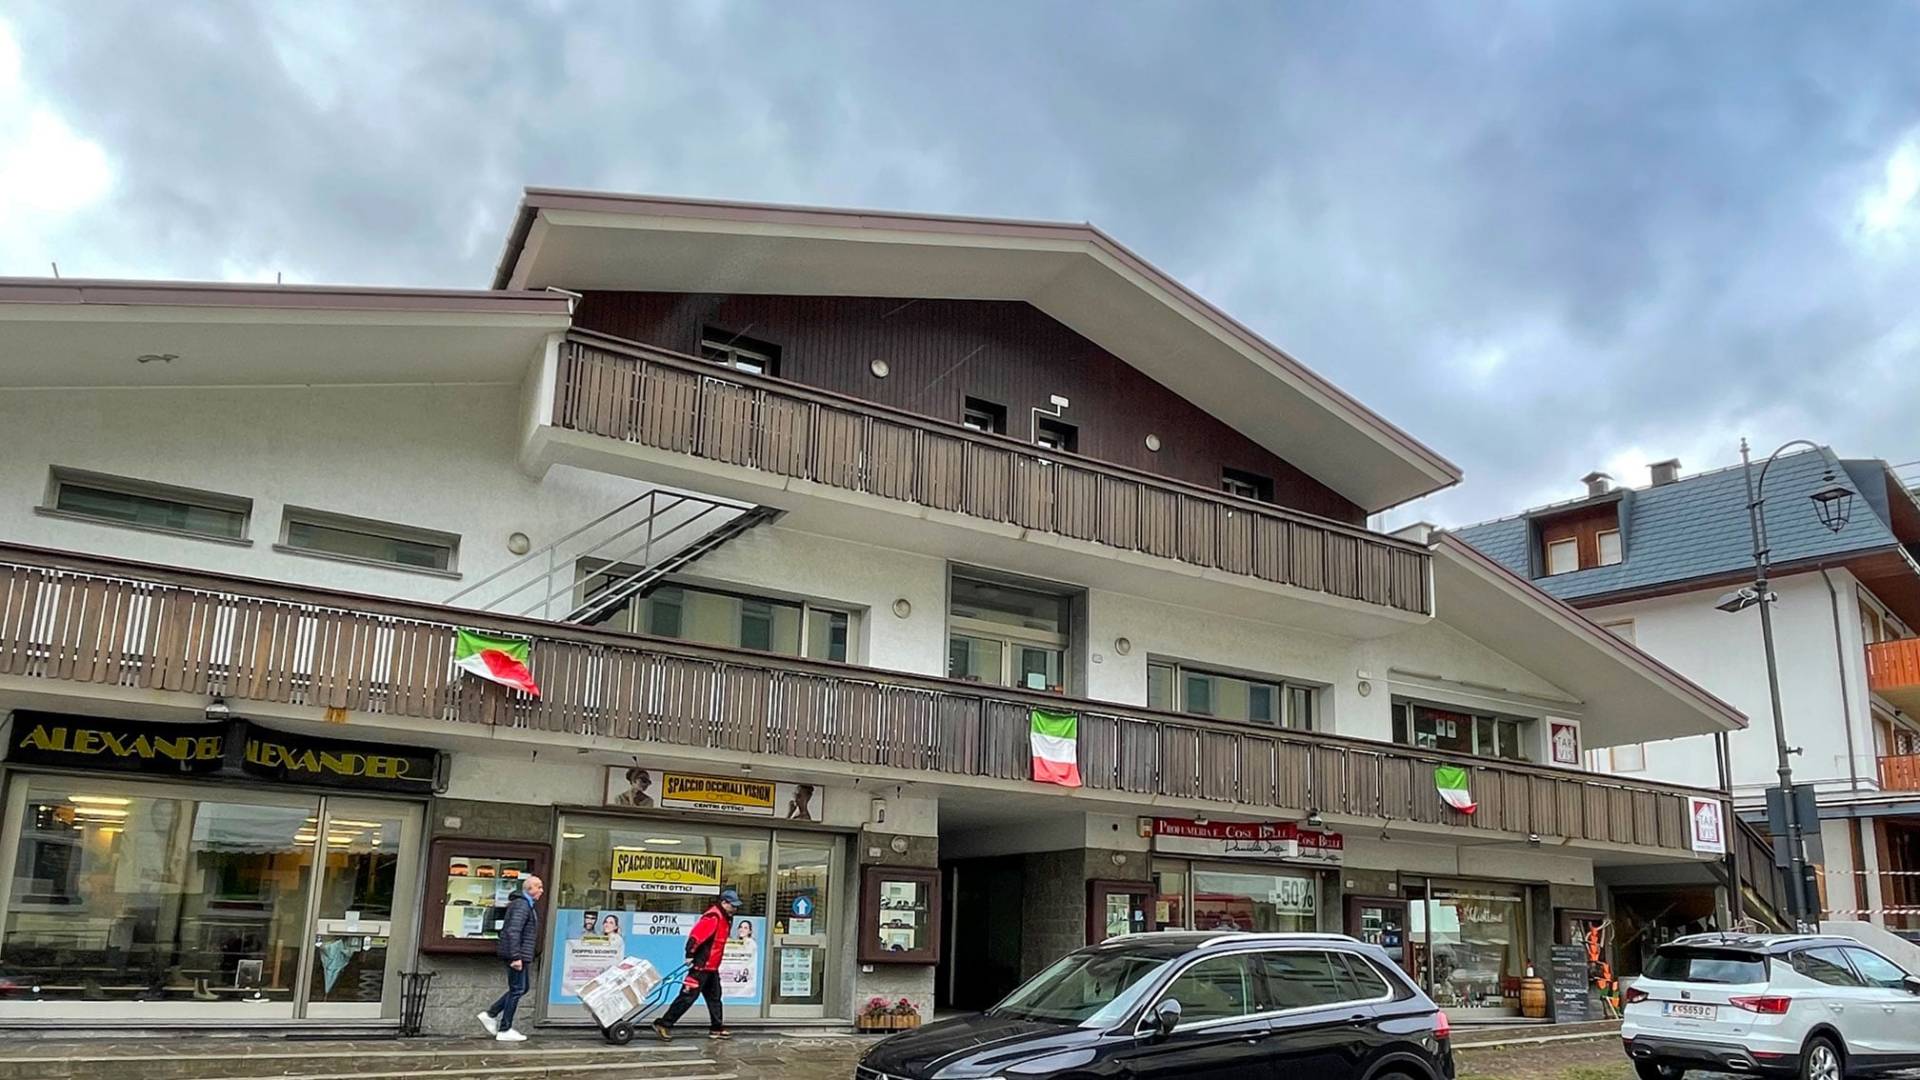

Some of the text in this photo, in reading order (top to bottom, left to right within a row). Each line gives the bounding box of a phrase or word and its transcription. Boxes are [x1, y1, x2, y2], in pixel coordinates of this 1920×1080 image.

[667, 777, 771, 802] SPACCIO OCCHIALI VISION
[617, 854, 717, 880] SPACCIO OCCHIALI VISION
[651, 914, 678, 924] OPTIK
[649, 925, 681, 935] OPTIKA
